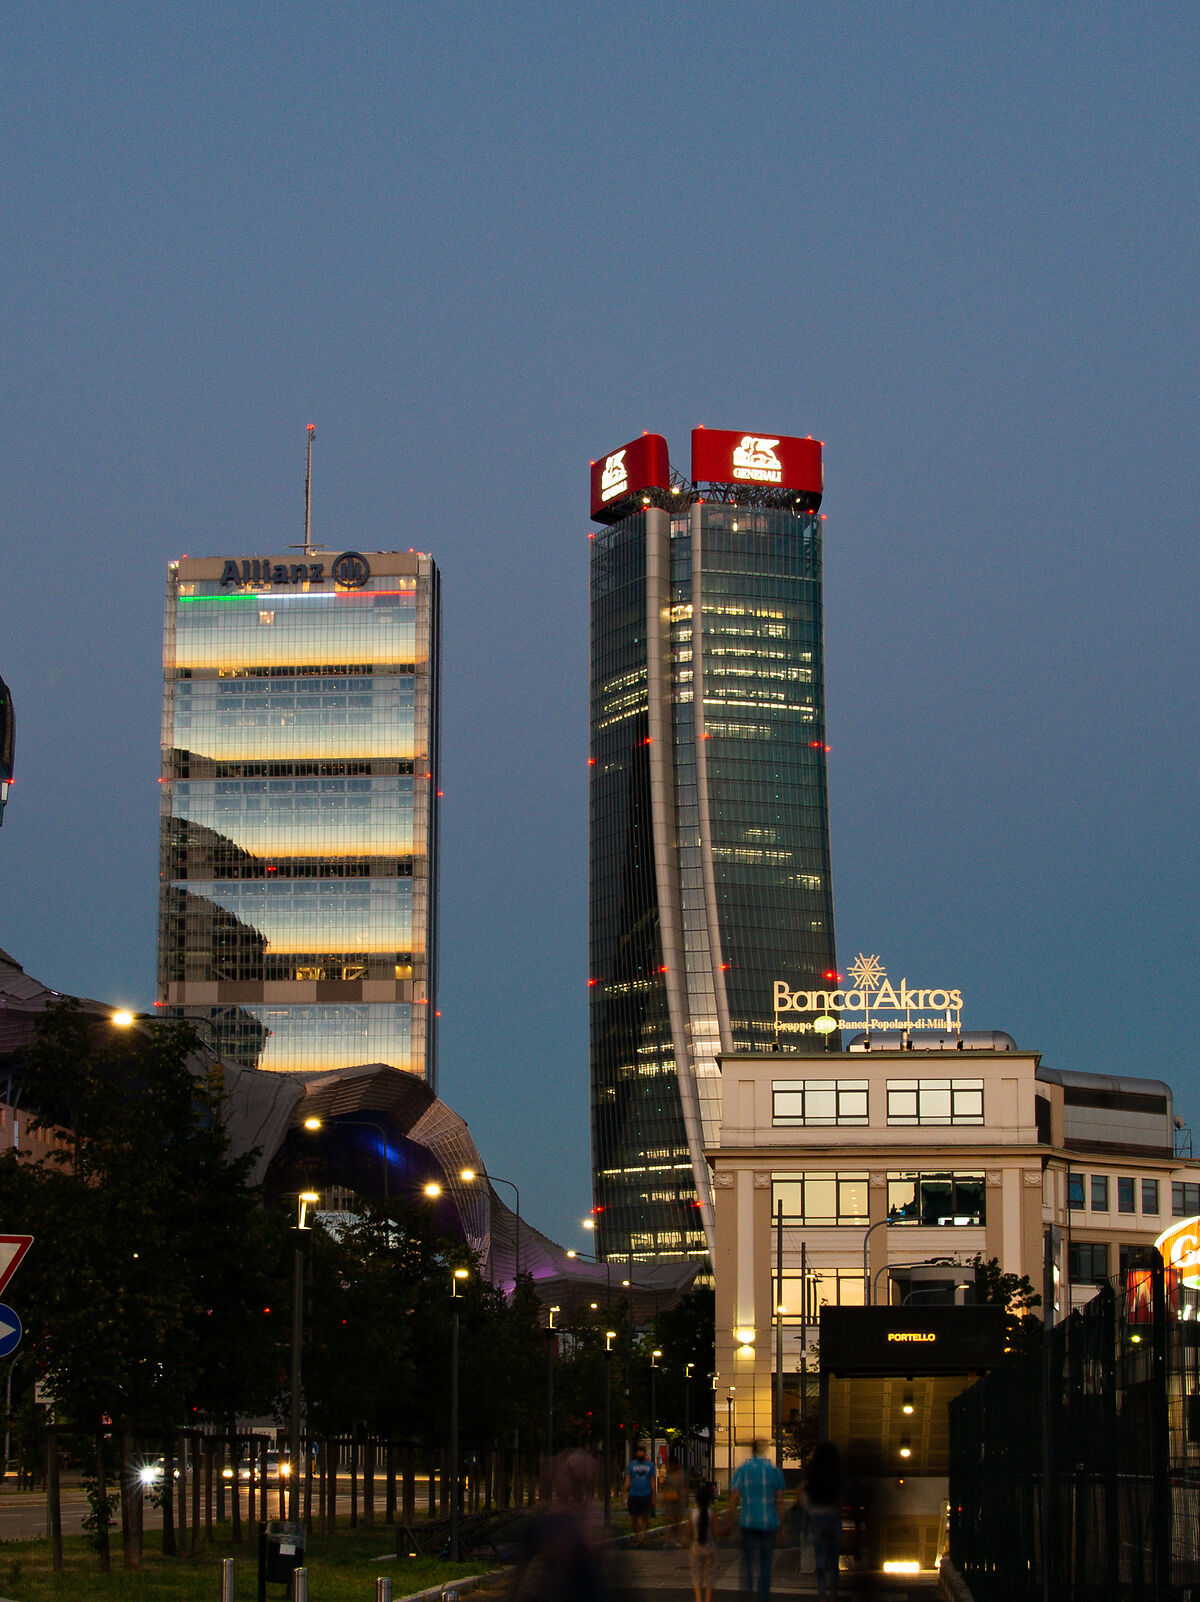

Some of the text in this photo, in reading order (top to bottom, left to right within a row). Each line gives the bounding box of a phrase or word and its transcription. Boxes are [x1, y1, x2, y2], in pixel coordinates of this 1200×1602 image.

[733, 468, 782, 483] GENERALI
[220, 559, 325, 587] Allianz
[774, 977, 964, 1012] Banca Akros
[774, 1020, 814, 1035] Gruppo
[838, 1019, 869, 1030] Banca
[871, 1018, 914, 1032] Popolare
[915, 1018, 926, 1029] di
[887, 1333, 936, 1342] PORTELLO
